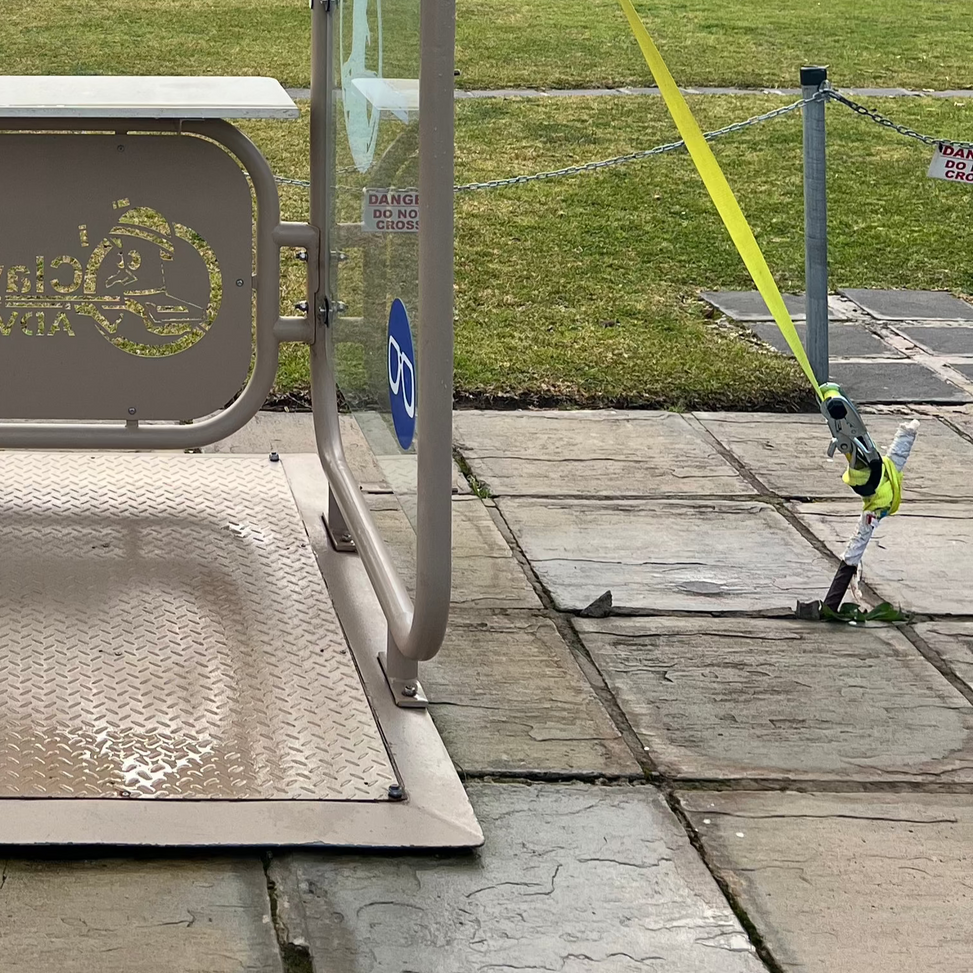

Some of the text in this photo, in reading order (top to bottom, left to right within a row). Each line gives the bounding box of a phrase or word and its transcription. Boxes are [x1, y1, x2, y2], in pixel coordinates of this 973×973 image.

[942, 145, 973, 160] DAN
[945, 160, 966, 170] DO
[945, 170, 973, 181] CRO
[368, 194, 420, 205] DANG
[373, 209, 419, 219] DO NO
